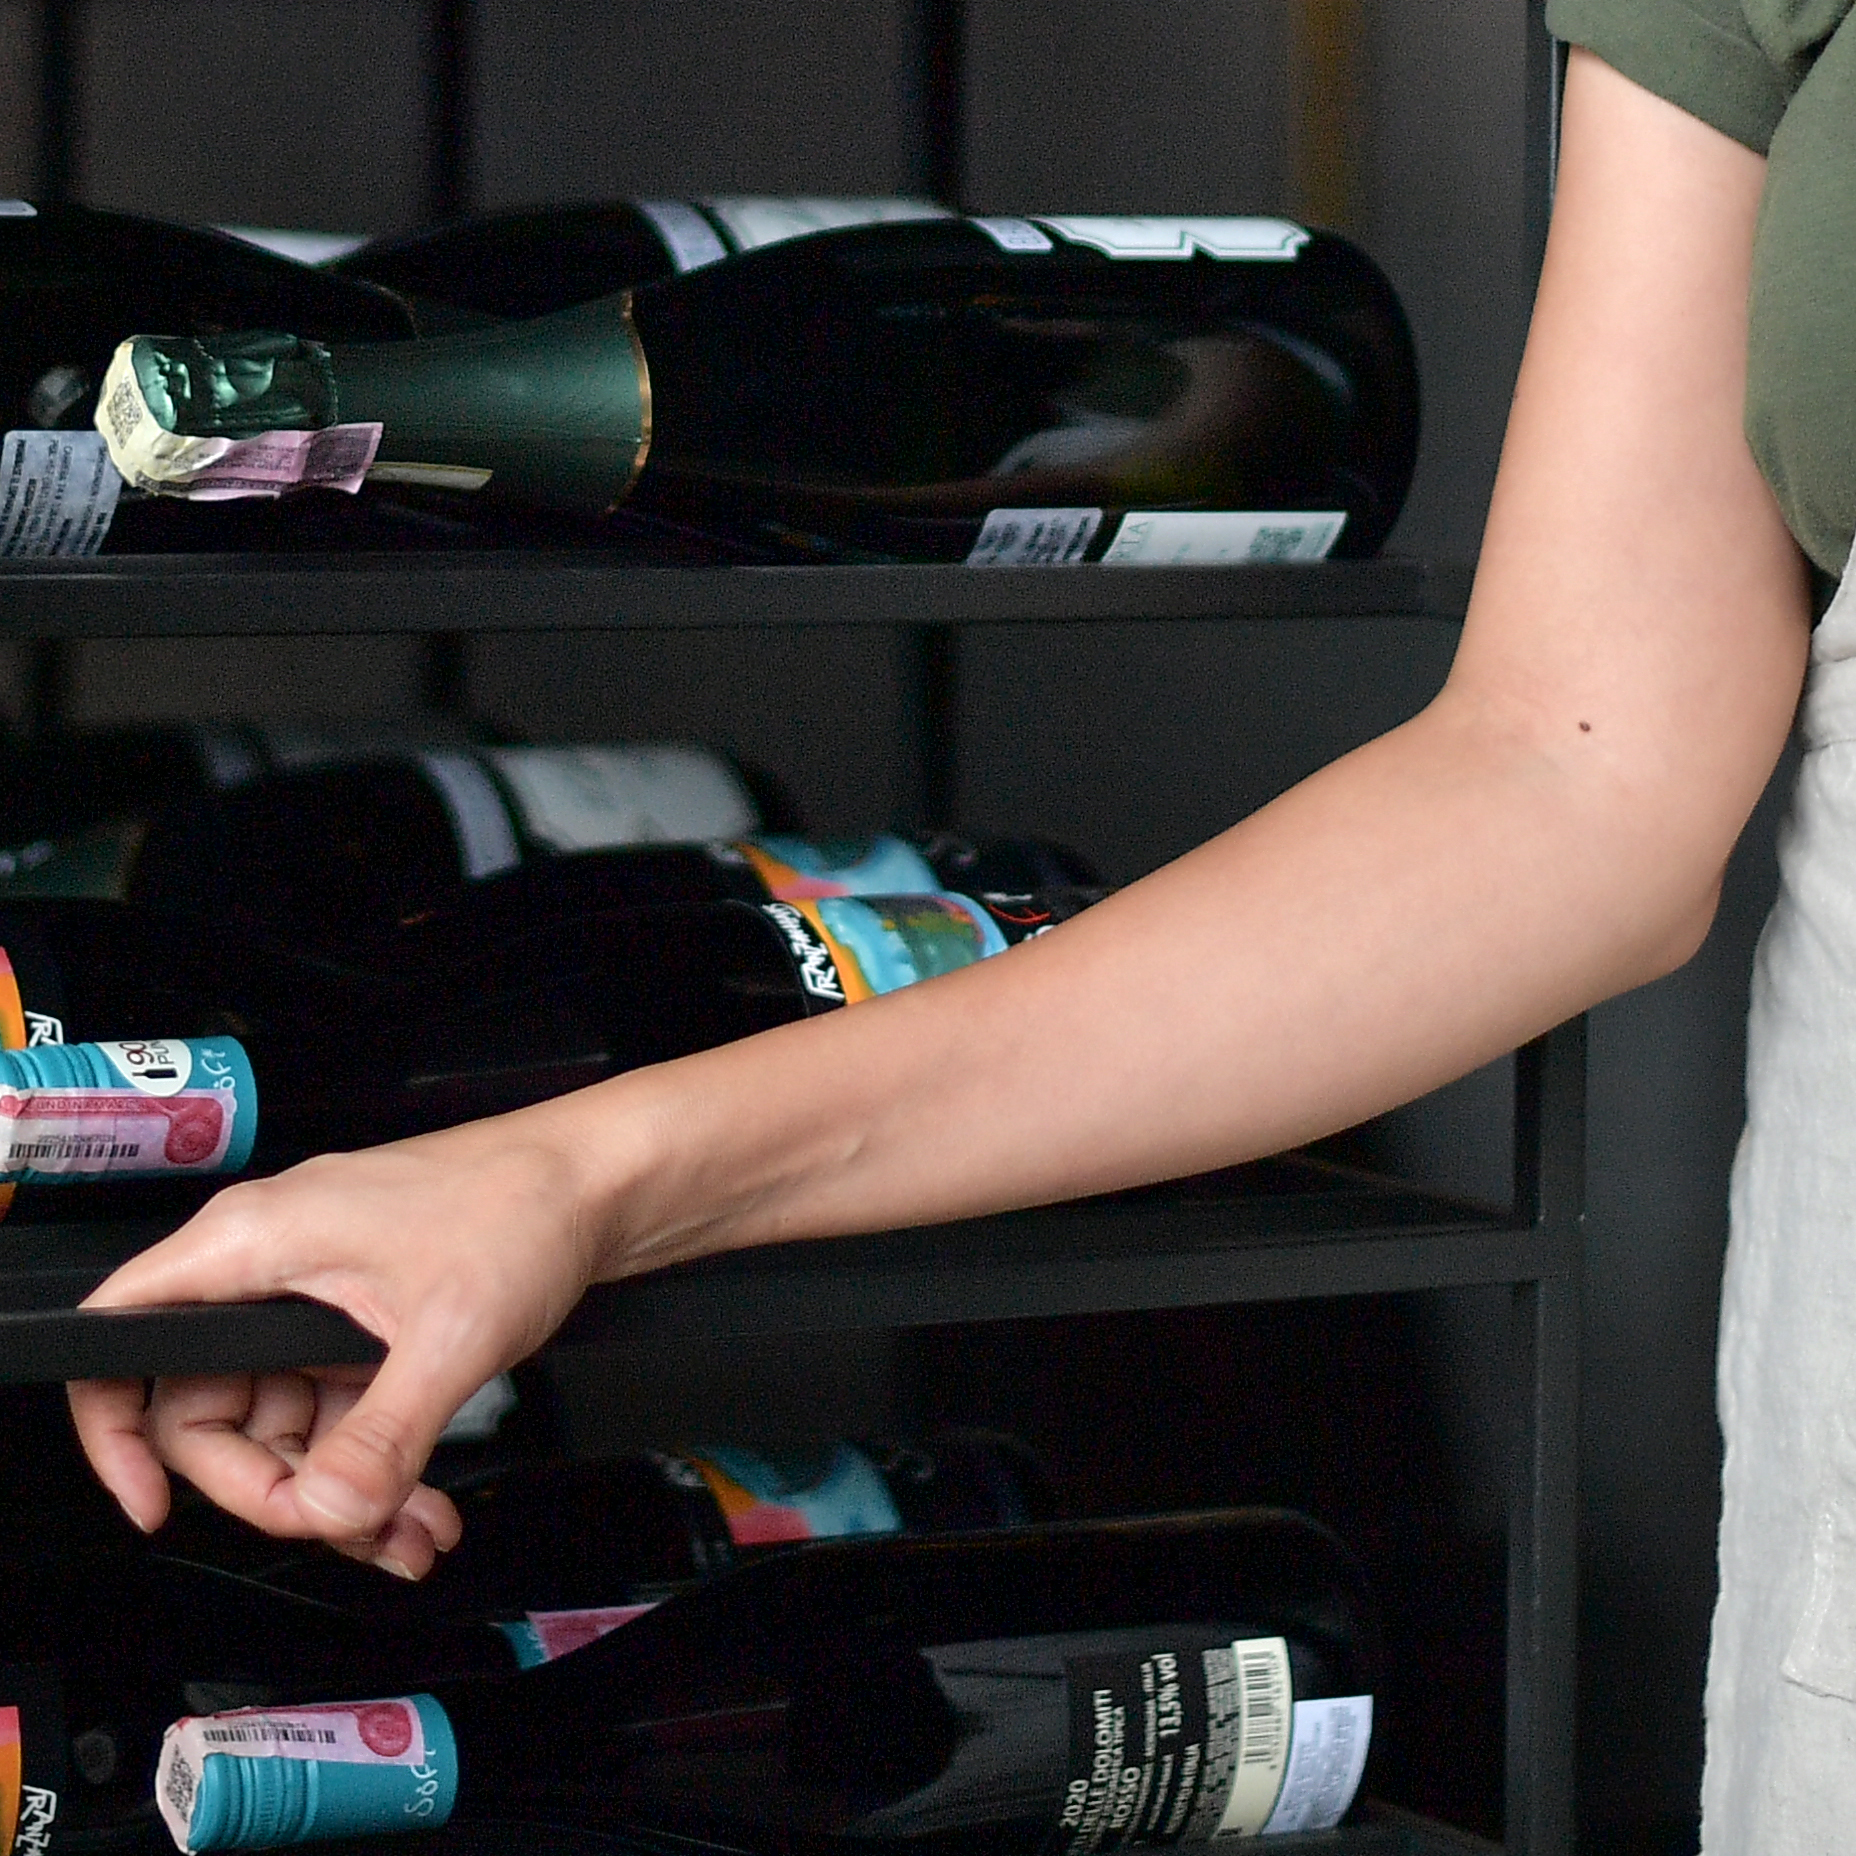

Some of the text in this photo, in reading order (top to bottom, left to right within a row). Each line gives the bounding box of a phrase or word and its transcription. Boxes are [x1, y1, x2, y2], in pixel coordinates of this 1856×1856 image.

[1091, 1689, 1113, 1784] DOLOMITI
[14, 1785, 57, 1848] FRANZ
[1058, 1779, 1090, 1829] 2020
[1109, 1766, 1142, 1829] ROSSO
